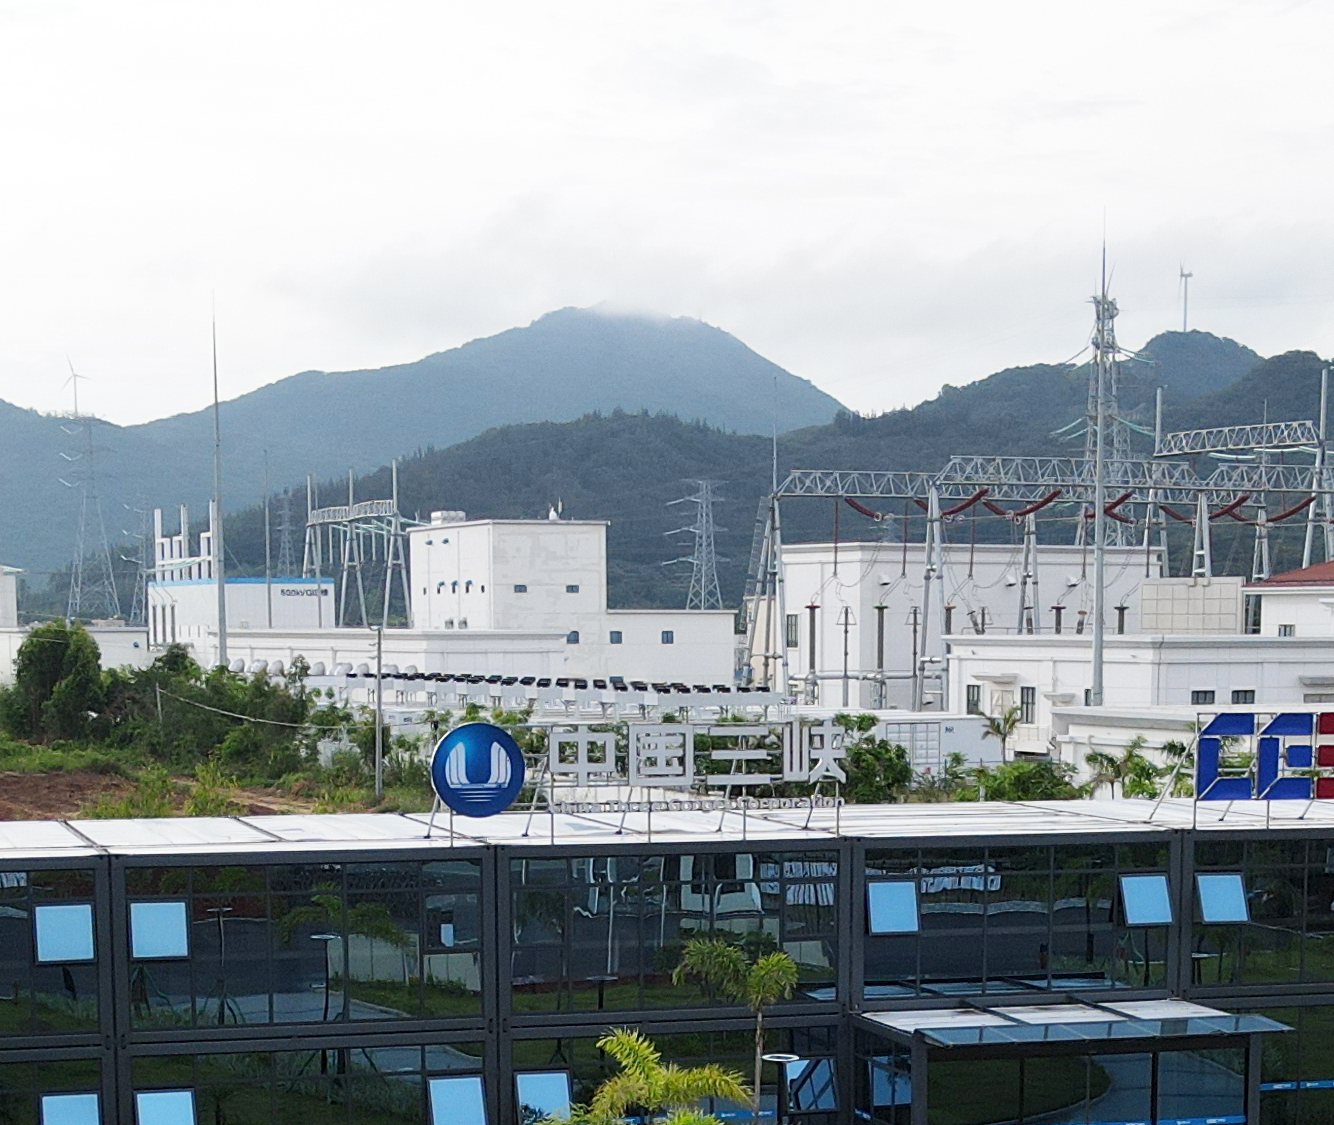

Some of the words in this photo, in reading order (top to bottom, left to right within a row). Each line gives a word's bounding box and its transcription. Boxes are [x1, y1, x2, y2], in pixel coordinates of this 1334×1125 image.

[548, 717, 848, 788] 中国三峡
[737, 793, 847, 812] Corporation
